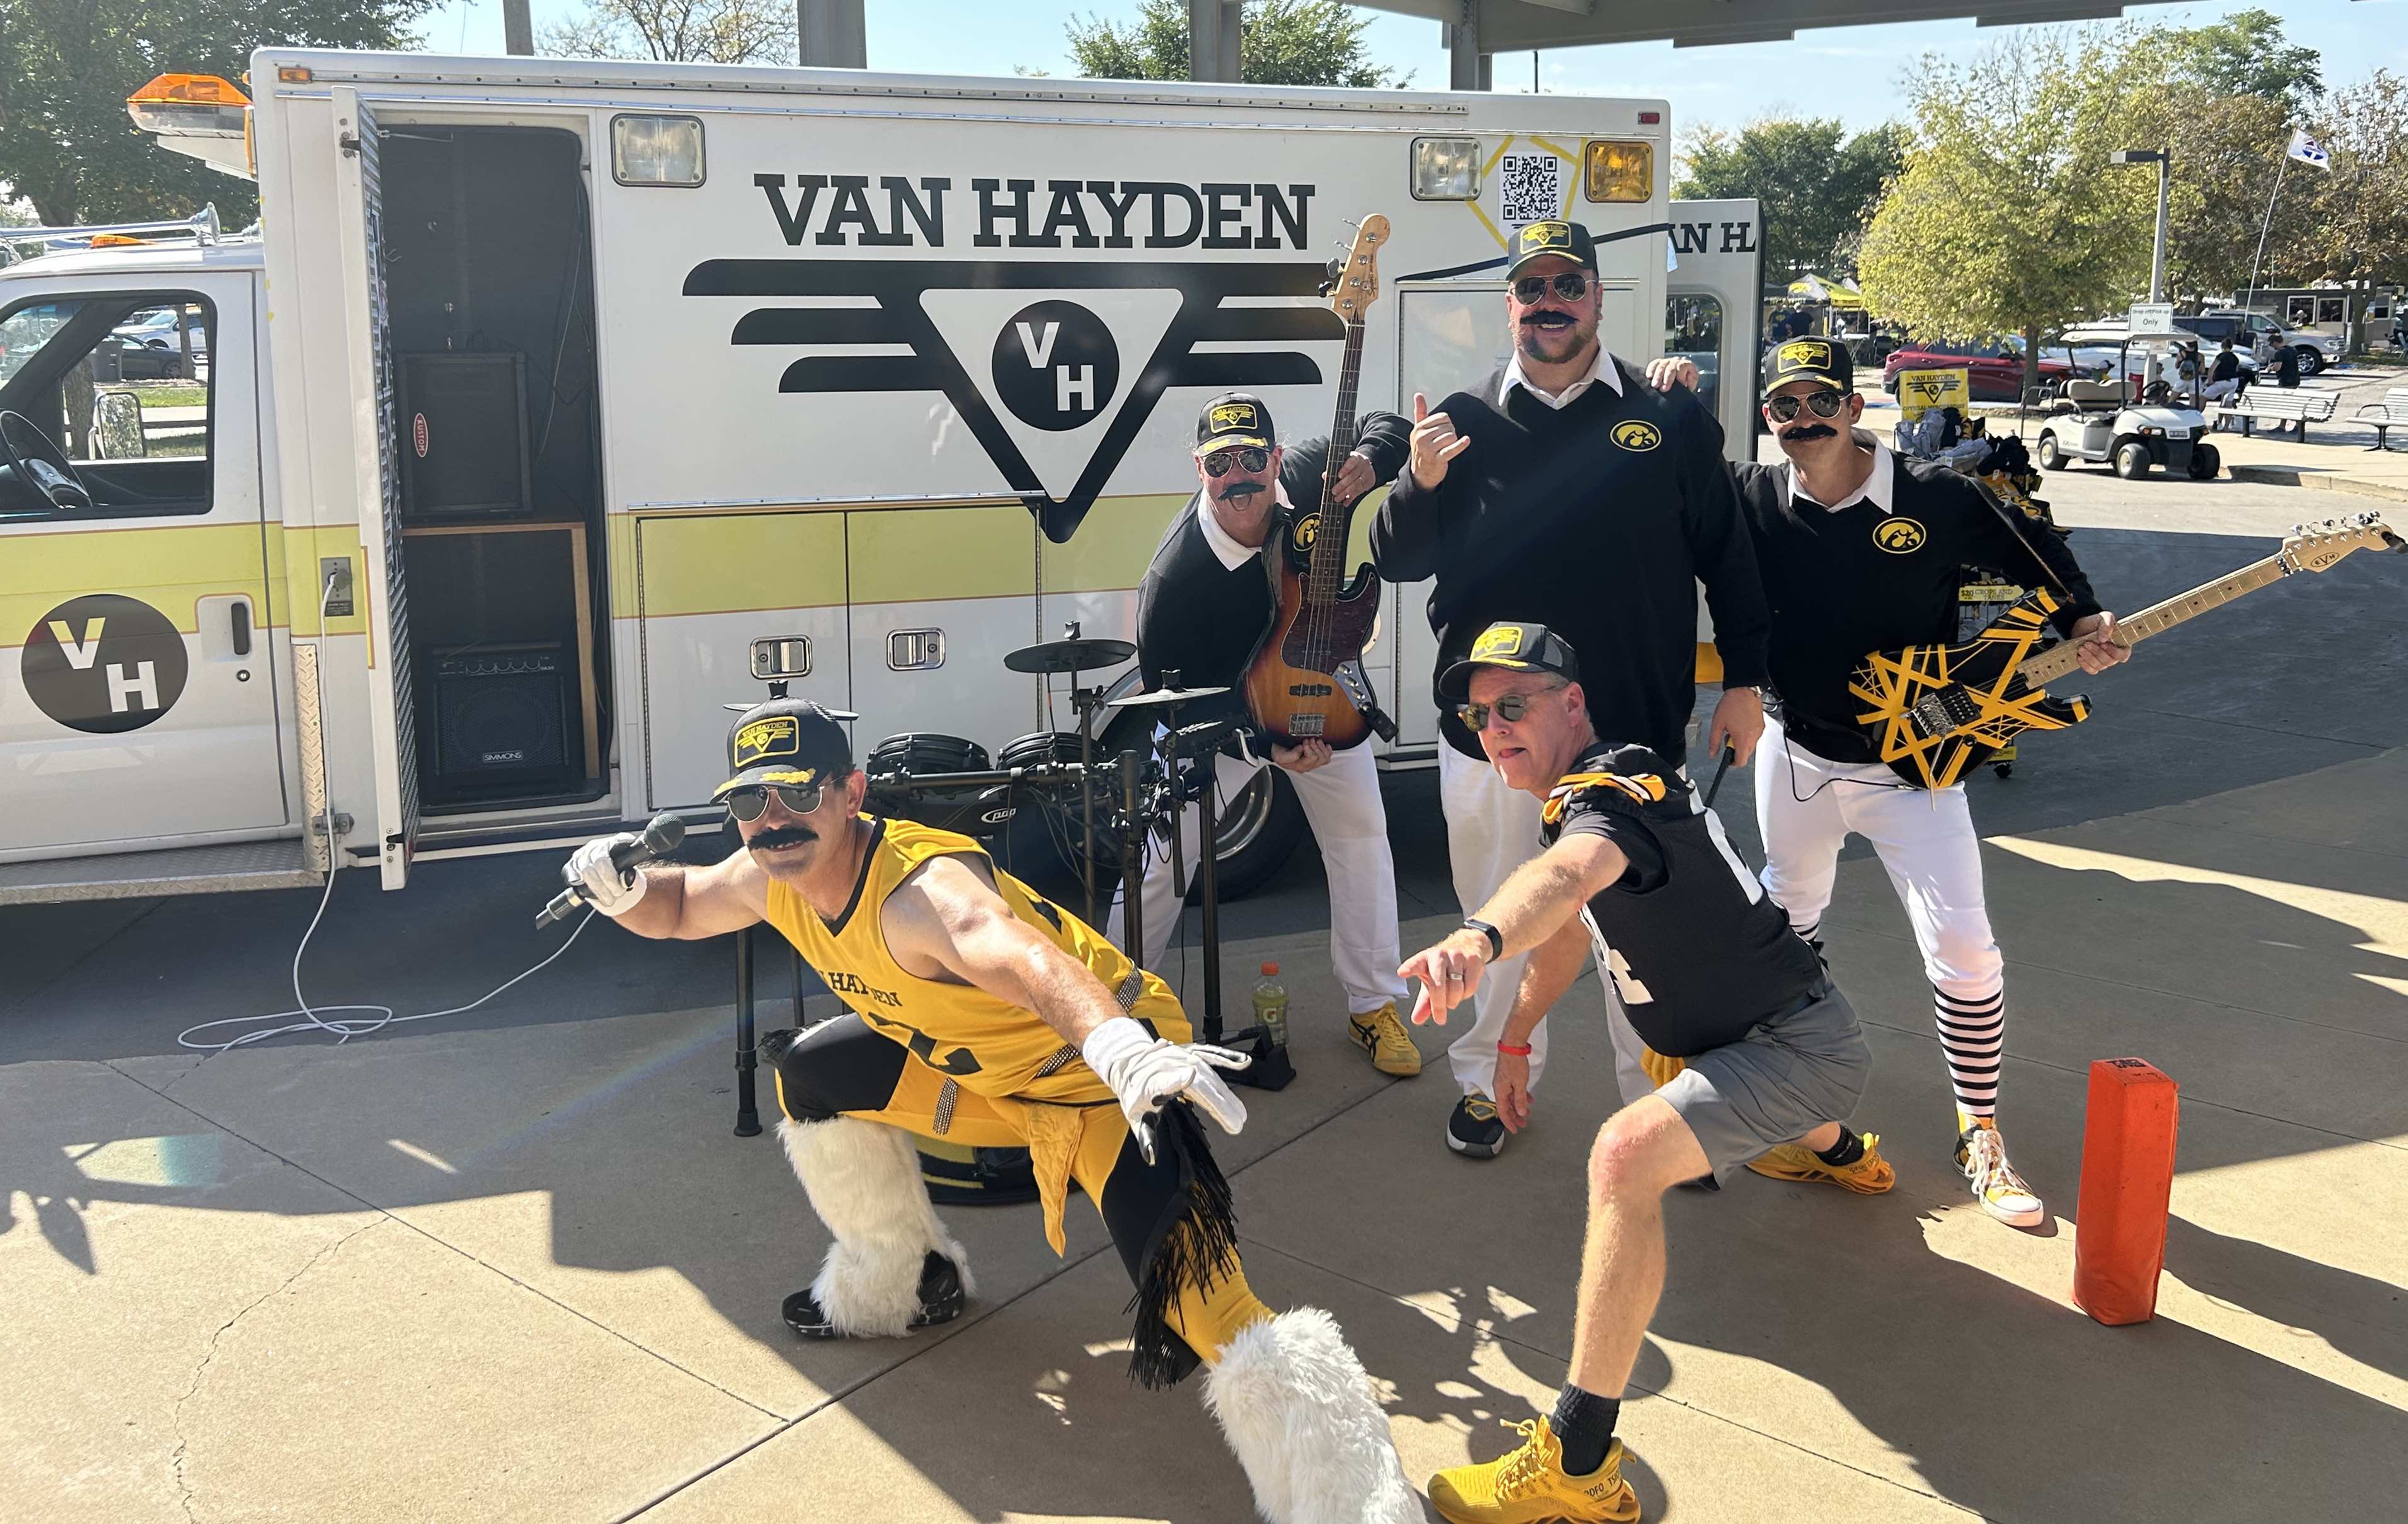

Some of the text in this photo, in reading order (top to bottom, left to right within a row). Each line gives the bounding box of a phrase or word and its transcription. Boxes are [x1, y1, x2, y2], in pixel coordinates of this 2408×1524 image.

[754, 173, 1316, 251] VAN HAYDEN
[2142, 318, 2159, 326] Only
[1926, 373, 1956, 382] HAYDEN
[416, 419, 425, 452] KUSTOM
[756, 721, 789, 733] HAYDEN
[484, 752, 522, 761] SIMMONS
